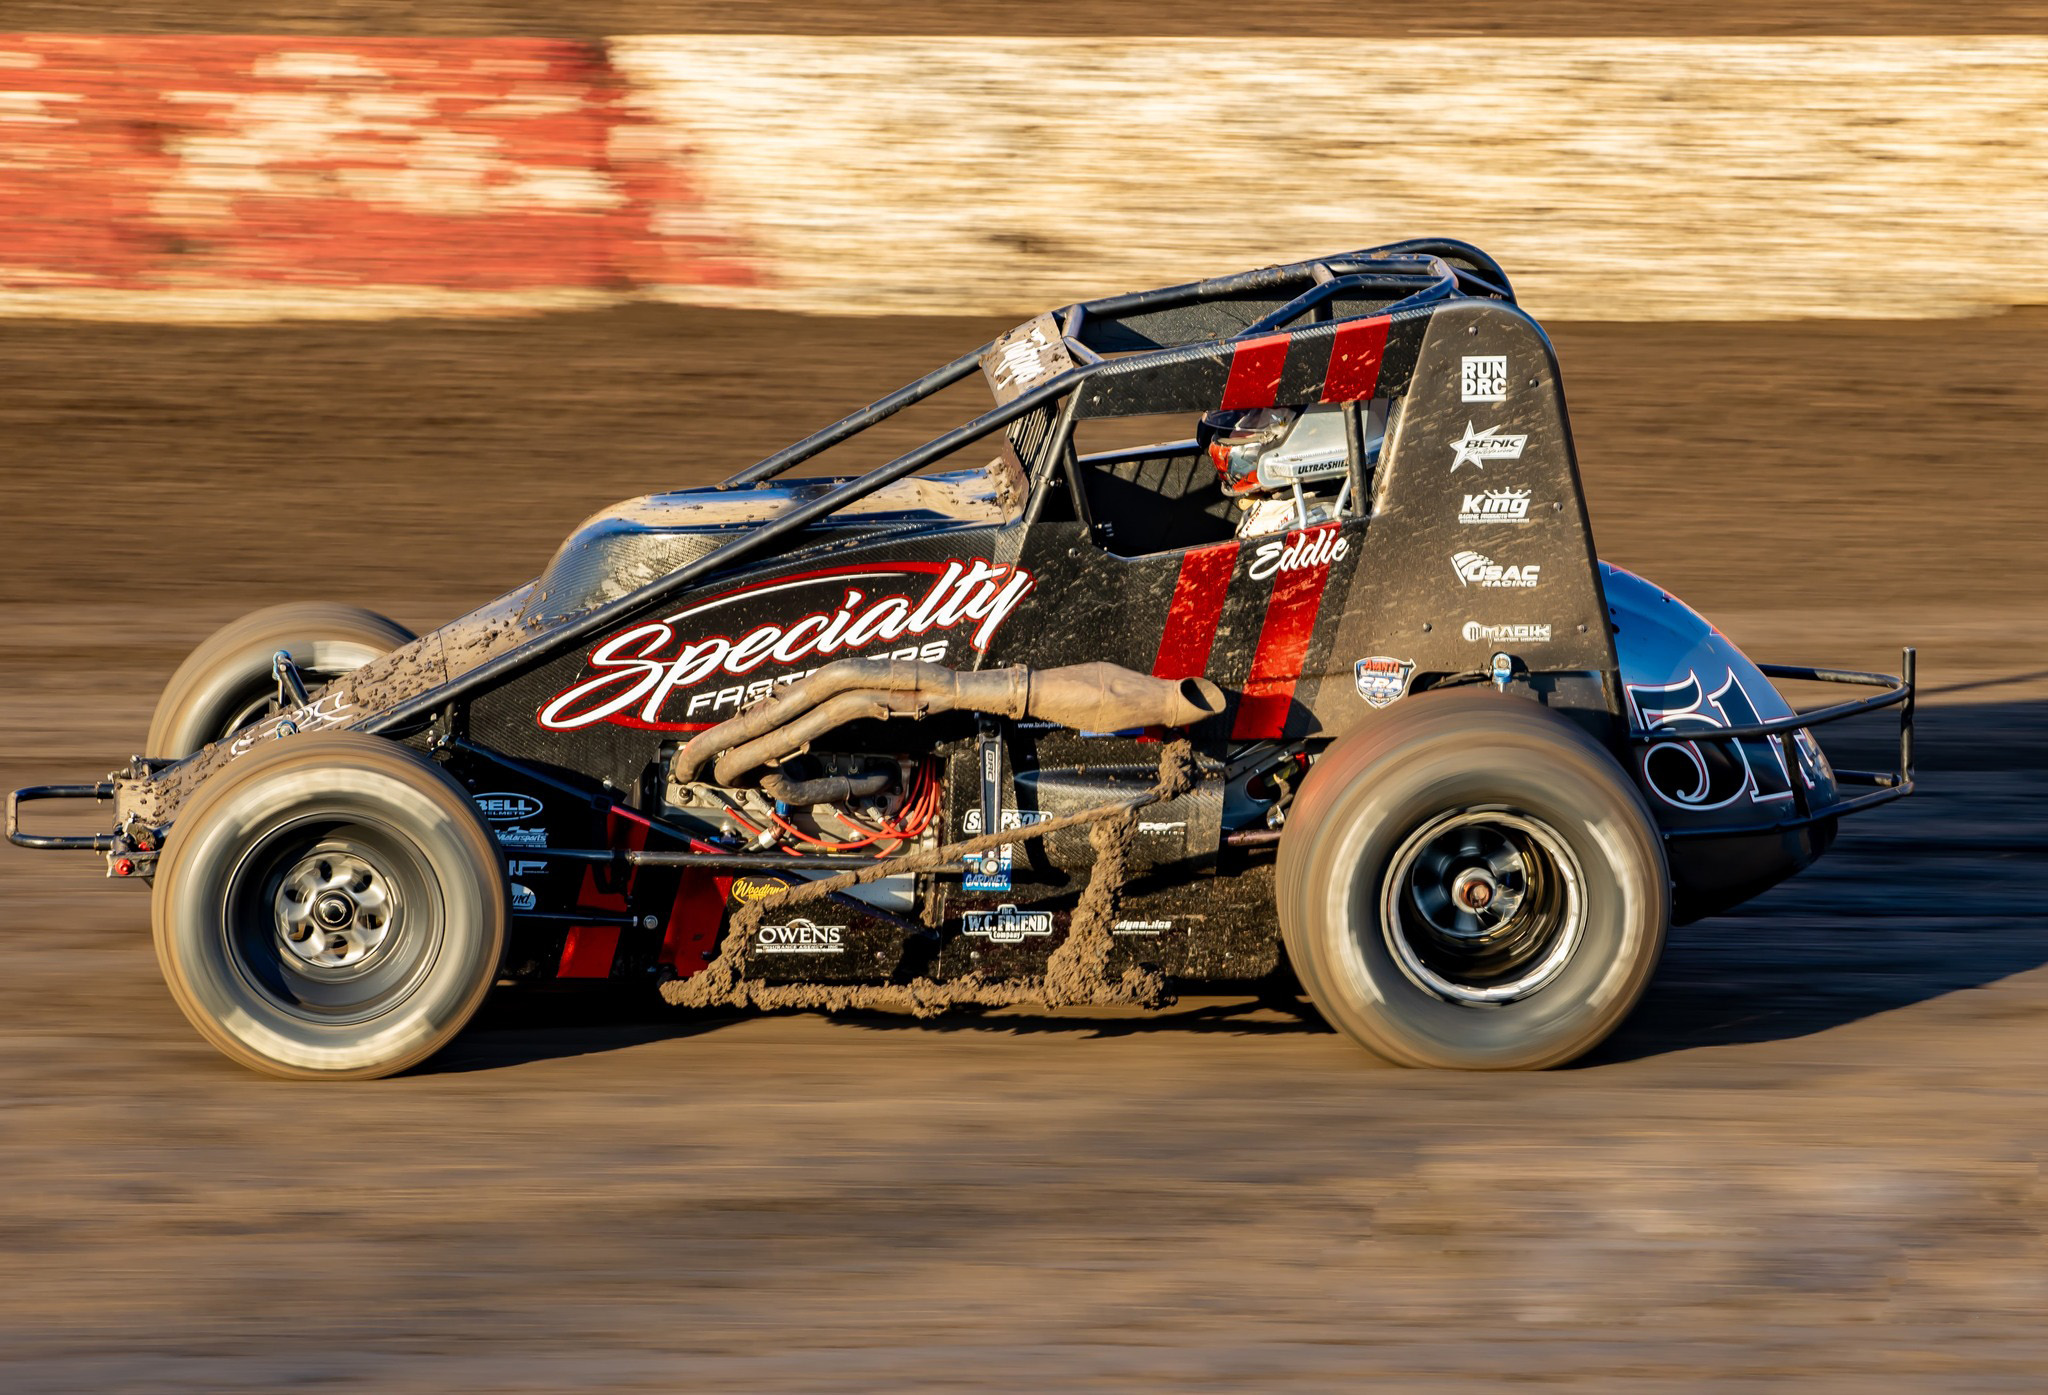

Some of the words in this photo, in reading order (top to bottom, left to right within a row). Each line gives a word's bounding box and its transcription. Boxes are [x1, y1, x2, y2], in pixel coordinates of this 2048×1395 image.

[1462, 362, 1506, 379] RUN
[1462, 379, 1506, 395] DRC
[1465, 439, 1522, 448] BENIC
[1461, 494, 1531, 518] King
[1249, 529, 1349, 580] Eddie
[1466, 566, 1540, 581] USAC
[539, 559, 1034, 729] Specialty
[476, 800, 532, 811] BELL
[759, 927, 840, 943] OWENS
